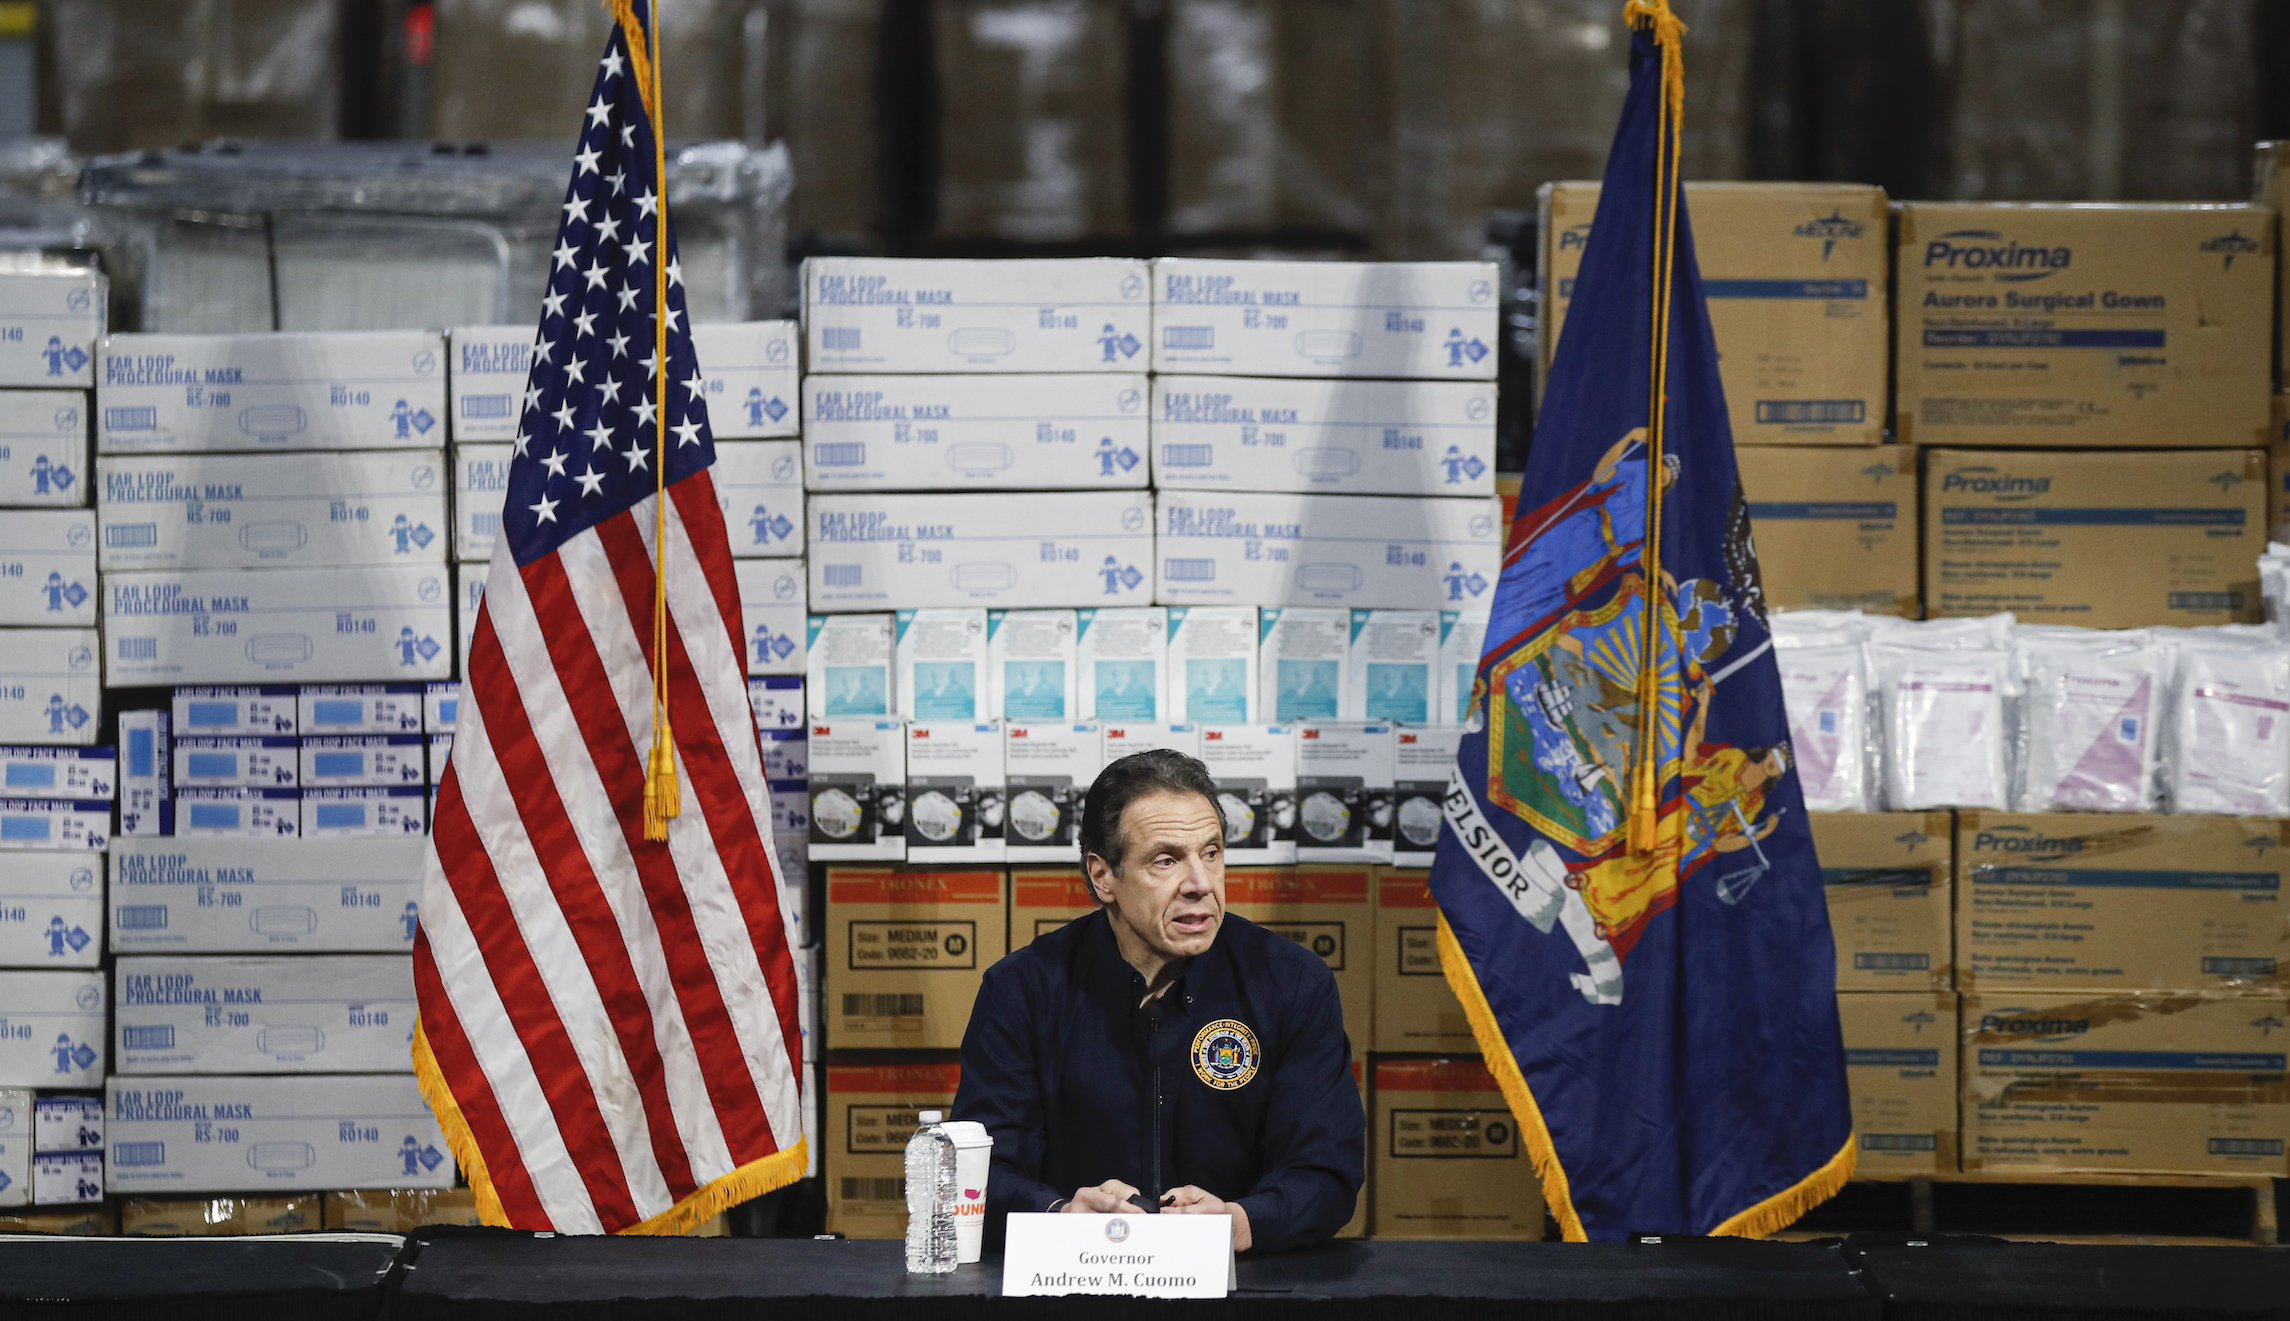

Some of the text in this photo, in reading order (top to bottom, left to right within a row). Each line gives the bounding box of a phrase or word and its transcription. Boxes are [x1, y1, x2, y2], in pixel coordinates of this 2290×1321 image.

[1924, 242, 2072, 269] Proxima
[820, 276, 886, 290] EAR LOOP
[1166, 276, 1234, 289] EAR LOOP
[820, 290, 954, 305] PROCEDURAL MASK
[1264, 292, 1300, 306] MASK
[1924, 291, 2166, 312] Aurora Surgical Gown
[464, 344, 530, 358] EAR LOOP
[108, 356, 174, 370] EAR LOOP
[108, 368, 243, 385] PROCEDURAL MASK
[188, 392, 230, 407] RS-700
[816, 392, 883, 406] EAR LOOP
[1165, 394, 1232, 408] EAR LOOP
[816, 406, 950, 420] PROCEDURAL MASK
[1262, 409, 1298, 423] MASK
[468, 462, 493, 475] EAR
[108, 473, 174, 487] EAR LOOP
[1943, 474, 2051, 493] Proxima
[108, 484, 243, 502] PROCEDURAL MASK
[188, 510, 230, 524] RS-700
[820, 512, 887, 526] EAR LOOP
[1169, 508, 1235, 522] EAR LOOP
[820, 526, 954, 541] PROCEDURAL MASK
[1264, 524, 1302, 539] MASK
[115, 585, 181, 600] EAR LOOP
[115, 598, 249, 615] PROCEDURAL MASK
[194, 622, 236, 636] RS-700
[176, 688, 212, 698] EARLOOP
[238, 688, 261, 698] MASK
[301, 685, 339, 694] EARLOOP
[363, 684, 386, 694] MASK
[812, 726, 830, 736] 3M
[912, 729, 930, 738] 3M
[1010, 728, 1028, 738] 3M
[1107, 728, 1126, 738] 3M
[1205, 731, 1223, 740] 3M
[1302, 730, 1320, 739] 3M
[177, 738, 213, 748] EARLOOP
[240, 738, 262, 748] MASK
[303, 737, 340, 746] EARLOOP
[366, 736, 388, 746] MASK
[1398, 734, 1417, 744] 3M
[58, 749, 80, 760] MASK
[178, 789, 214, 798] EARLOOP
[304, 788, 340, 798] EARLOOP
[366, 788, 388, 798] MASK
[52, 802, 74, 812] MASK
[1446, 770, 1529, 900] ELSIOR
[1975, 834, 2084, 852] Proxima
[120, 855, 186, 869] EAR LOOP
[120, 868, 254, 884] PROCEDURAL MASK
[880, 878, 947, 891] TRONEX
[198, 893, 241, 907] RS-700
[888, 930, 938, 942] MEDIUM
[126, 975, 193, 990] EAR LOOP
[126, 988, 261, 1004] PROCEDURAL MASK
[206, 1012, 248, 1027] RS-700
[1981, 1016, 2090, 1034] Proxima
[1194, 1022, 1223, 1054] PERFORMANCE
[1198, 1067, 1212, 1084] WORK
[1238, 1066, 1256, 1084] PEOPLE
[116, 1092, 184, 1106] EAR LOOP
[116, 1104, 251, 1120] PROCEDURAL MASK
[196, 1128, 239, 1142] RS-700
[1079, 1252, 1155, 1265] Governor
[1030, 1272, 1197, 1287] Andrew M. Cuomo
